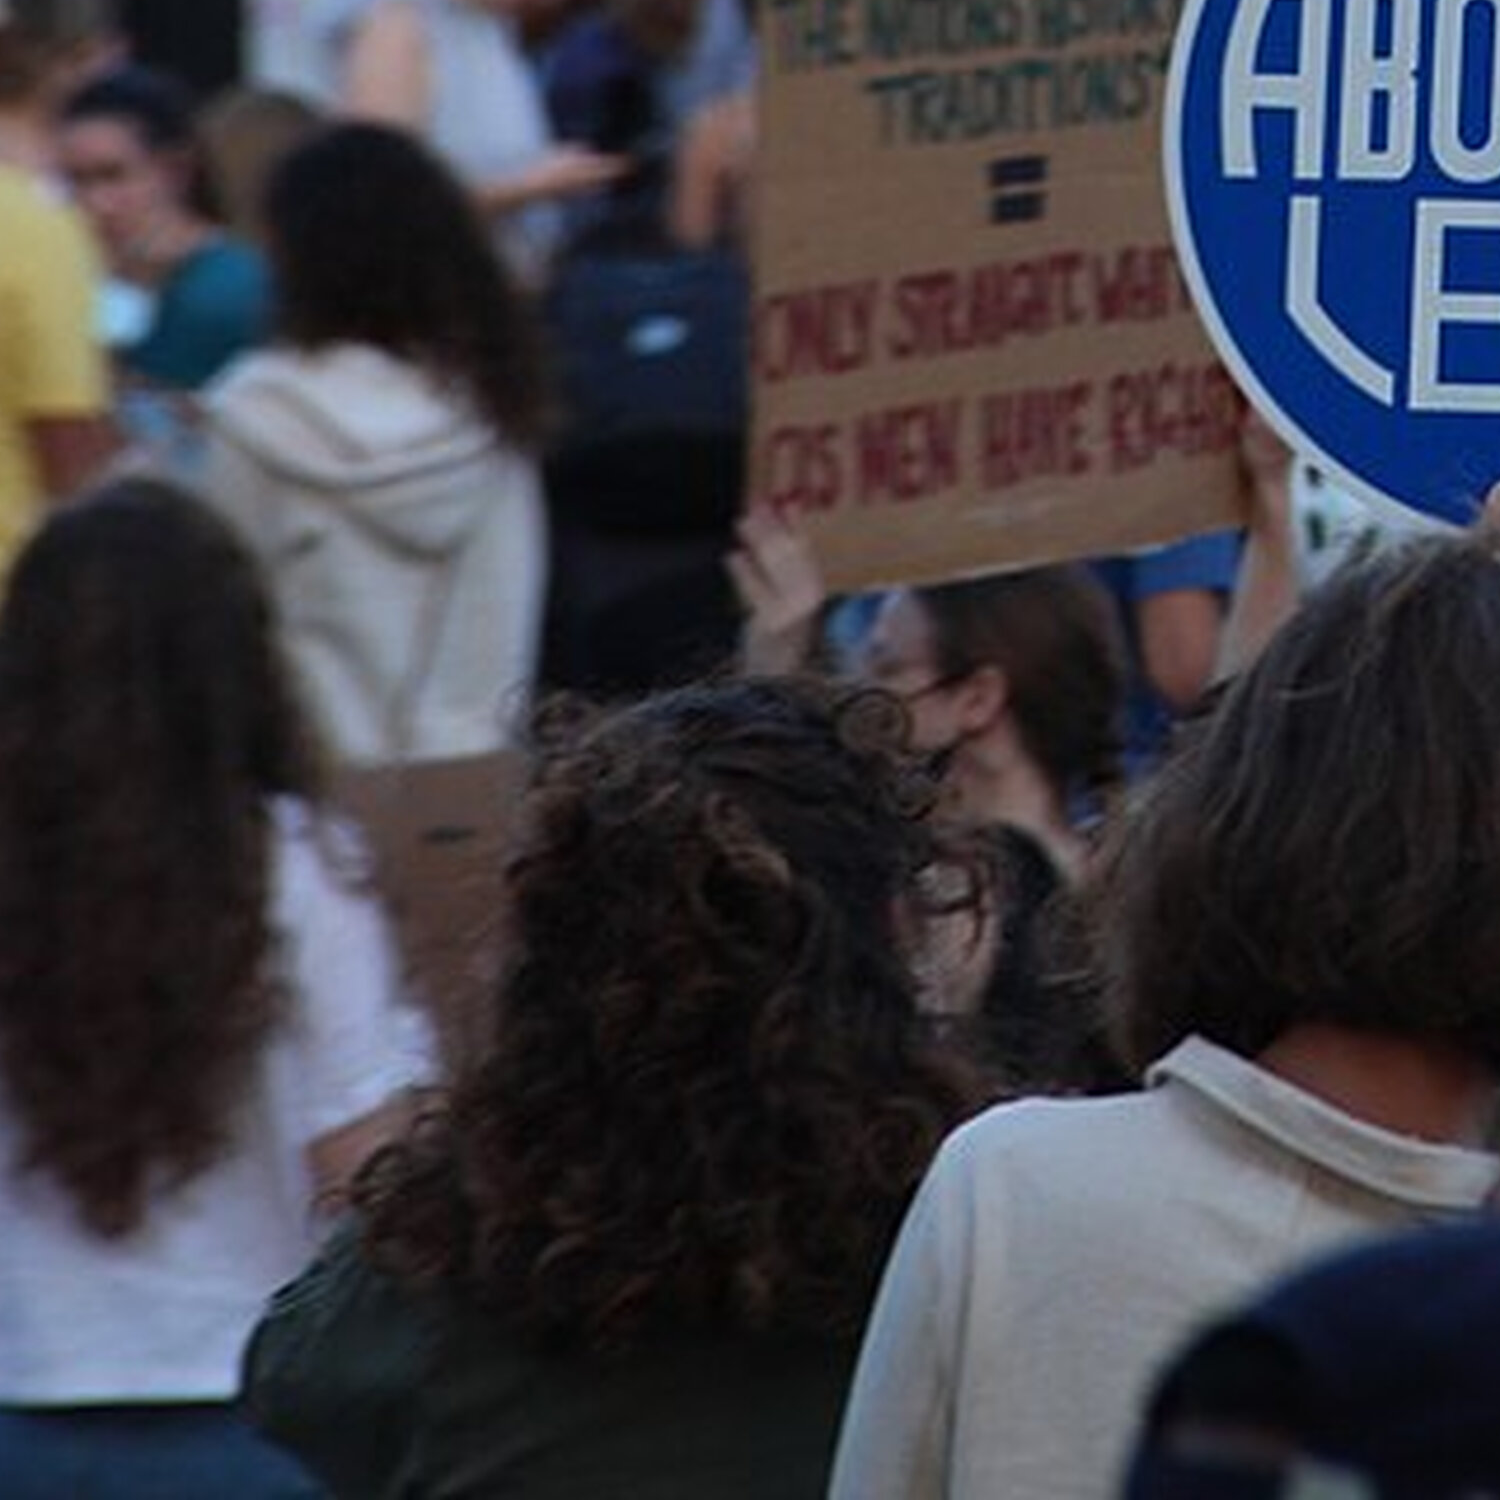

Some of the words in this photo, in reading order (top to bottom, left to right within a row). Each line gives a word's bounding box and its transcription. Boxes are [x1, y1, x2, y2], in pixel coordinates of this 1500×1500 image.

[750, 280, 880, 385] ONLY
[857, 396, 965, 508] MEN
[982, 381, 1092, 496] HAVE
